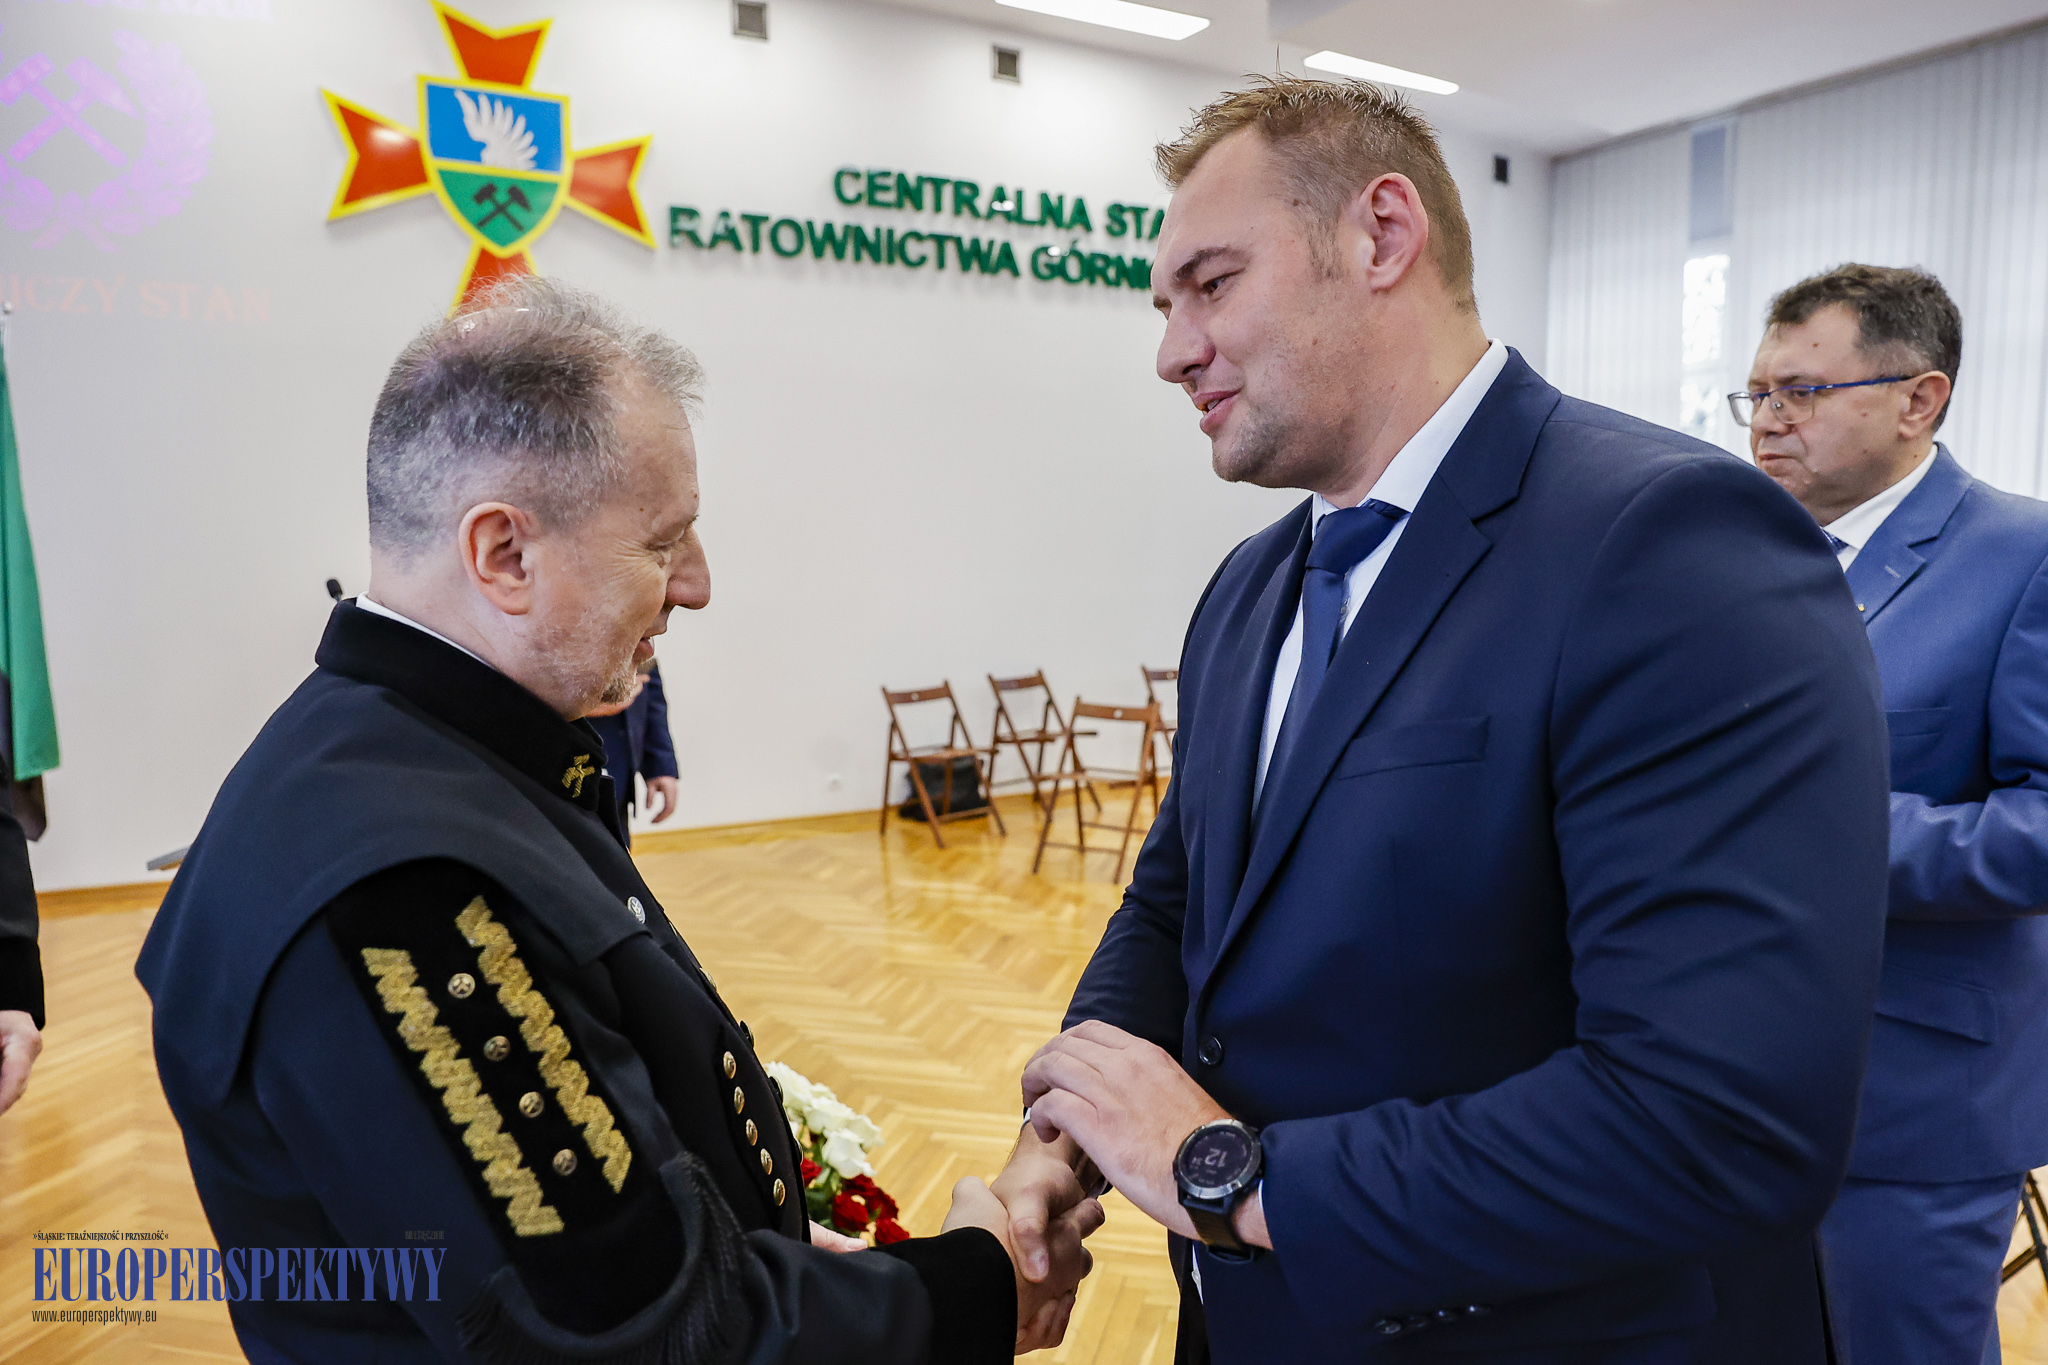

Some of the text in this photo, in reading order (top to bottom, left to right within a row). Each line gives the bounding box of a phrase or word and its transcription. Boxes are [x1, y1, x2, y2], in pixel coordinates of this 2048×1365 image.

[834, 168, 1093, 232] CENTRALNA
[669, 206, 1020, 278] RATOWNICTWA
[0, 272, 272, 324] ICZY STAN
[1204, 1147, 1228, 1168] 12
